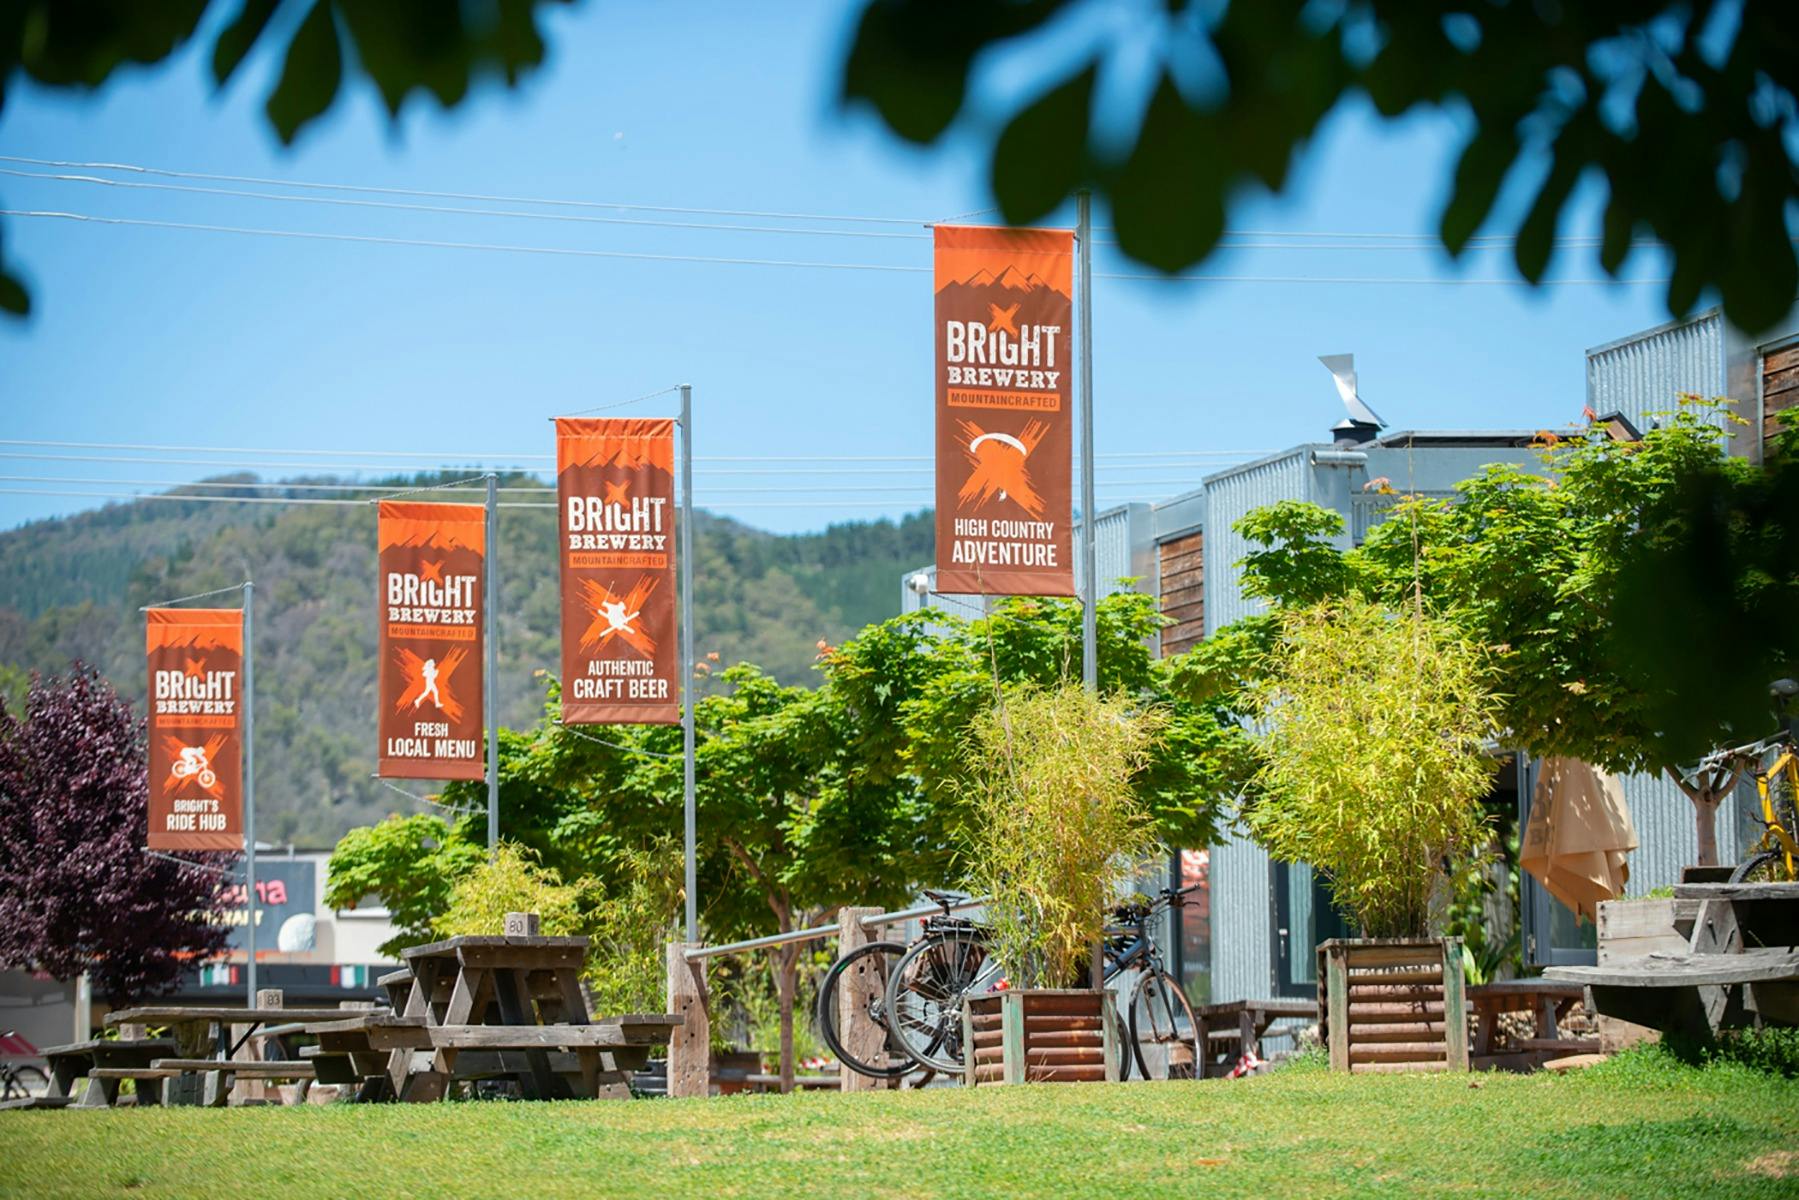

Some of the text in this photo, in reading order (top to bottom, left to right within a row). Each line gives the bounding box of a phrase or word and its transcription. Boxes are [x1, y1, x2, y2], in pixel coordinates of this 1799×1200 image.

[947, 320, 1060, 368] BRIGHT
[947, 366, 1060, 390] BREWERY
[950, 392, 1057, 408] MOUNTAINCRAFTED
[567, 496, 666, 533] BRIGHT
[954, 518, 1054, 540] HIGH COUNTRY
[569, 534, 667, 551] BREWERY
[572, 555, 665, 567] MOUNTAINCRAFTED
[952, 539, 1058, 567] ADVENTURE
[387, 572, 477, 608] BRIGHT
[388, 607, 477, 625] BREWERY
[588, 660, 654, 676] AUTHENTIC
[156, 670, 236, 700] BRIGHT
[573, 678, 668, 699] CRAFT BEER
[156, 700, 235, 714] BREWERY
[414, 722, 449, 737] FRESH
[387, 737, 476, 759] LOCAL MENU
[174, 799, 219, 813] BRIGHT'S
[166, 813, 227, 831] RIDE HUB
[508, 919, 523, 933] 80
[267, 994, 280, 1006] 83
